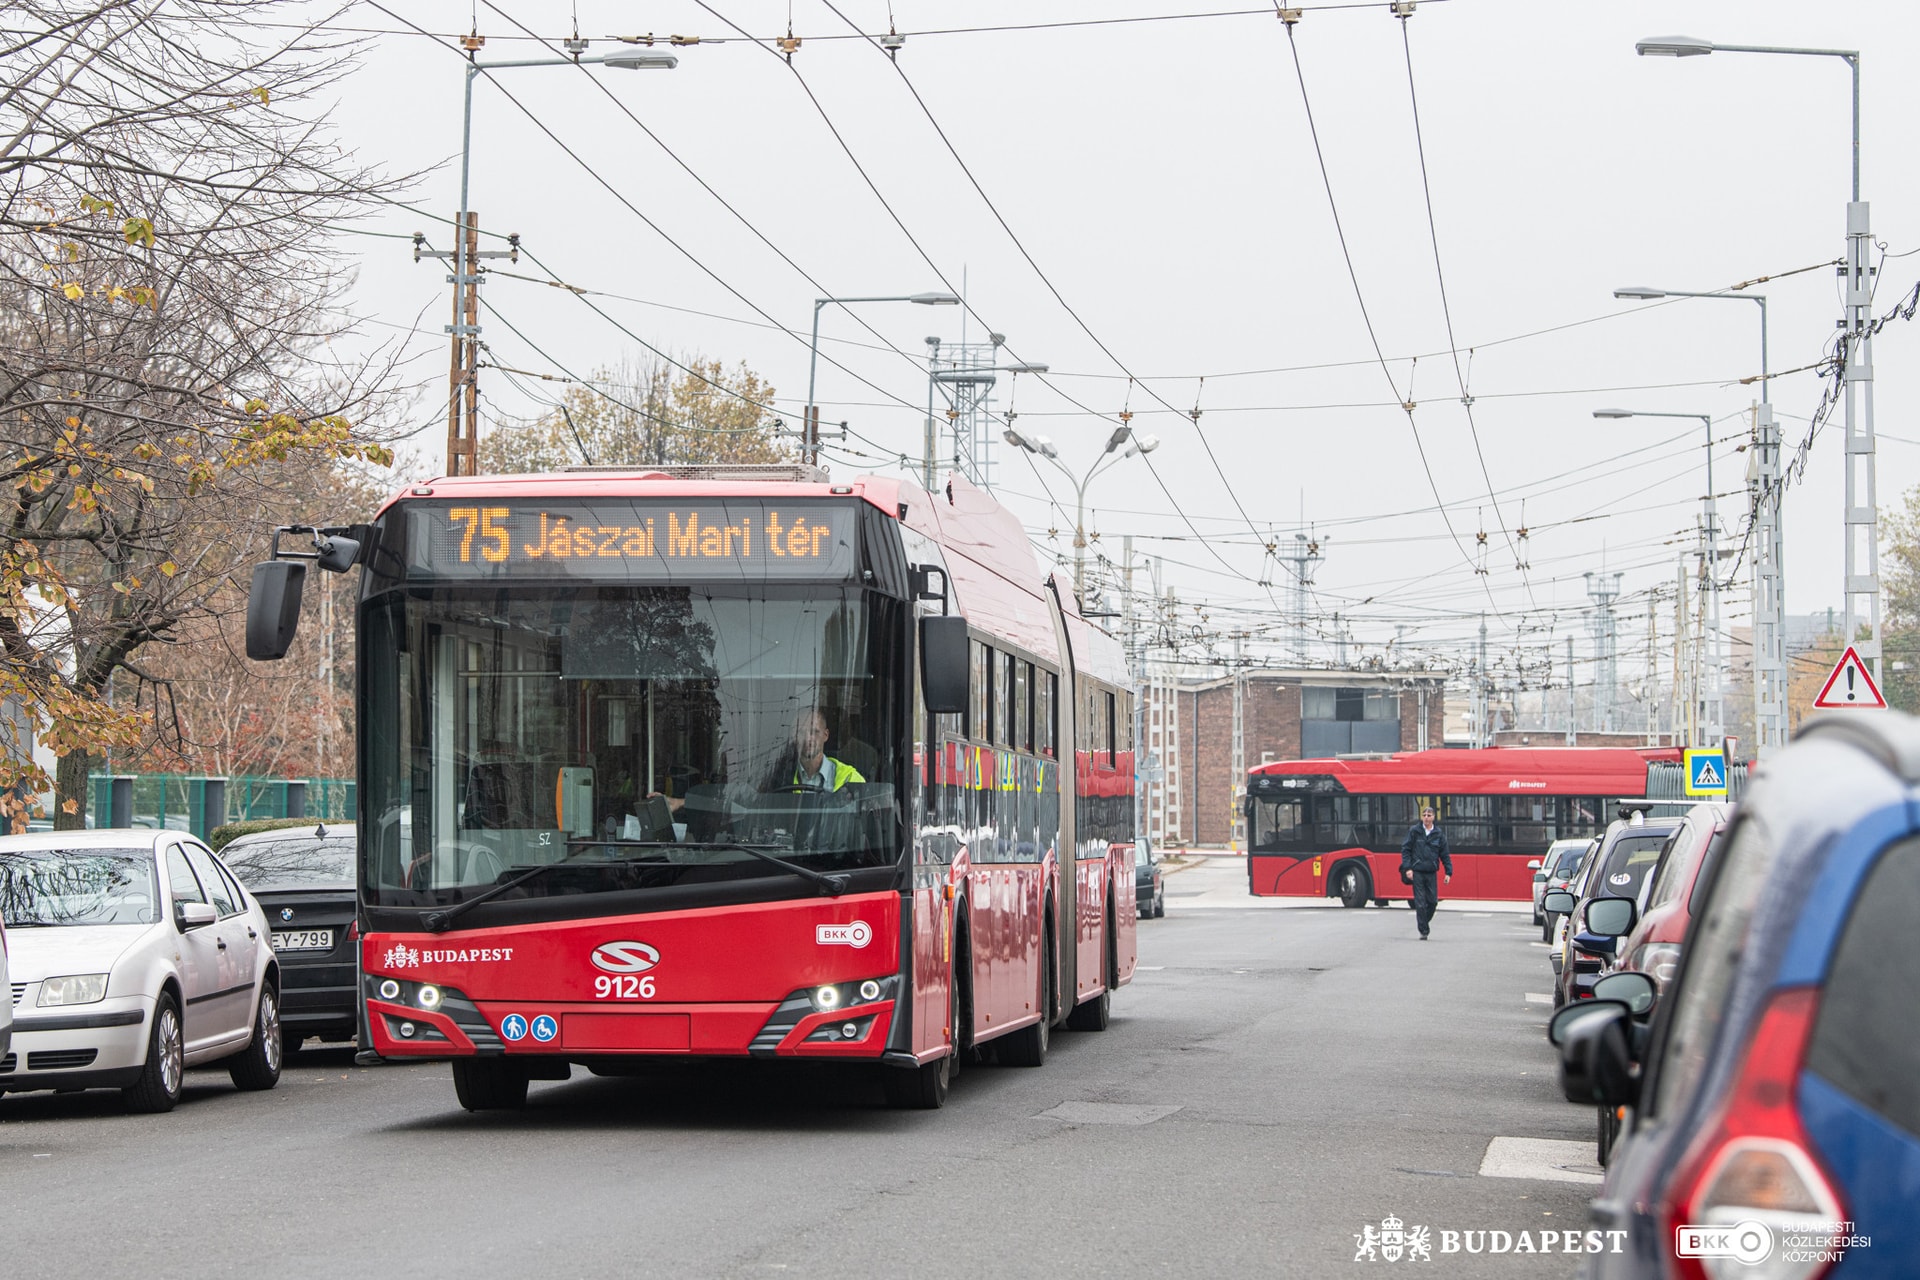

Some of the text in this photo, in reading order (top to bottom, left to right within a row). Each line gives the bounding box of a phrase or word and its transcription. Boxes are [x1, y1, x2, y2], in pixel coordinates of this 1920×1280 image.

[449, 508, 830, 562] 75 Jászai Mari tér
[824, 930, 847, 938] BKK
[422, 948, 513, 963] BUDAPEST
[594, 975, 656, 999] 9126
